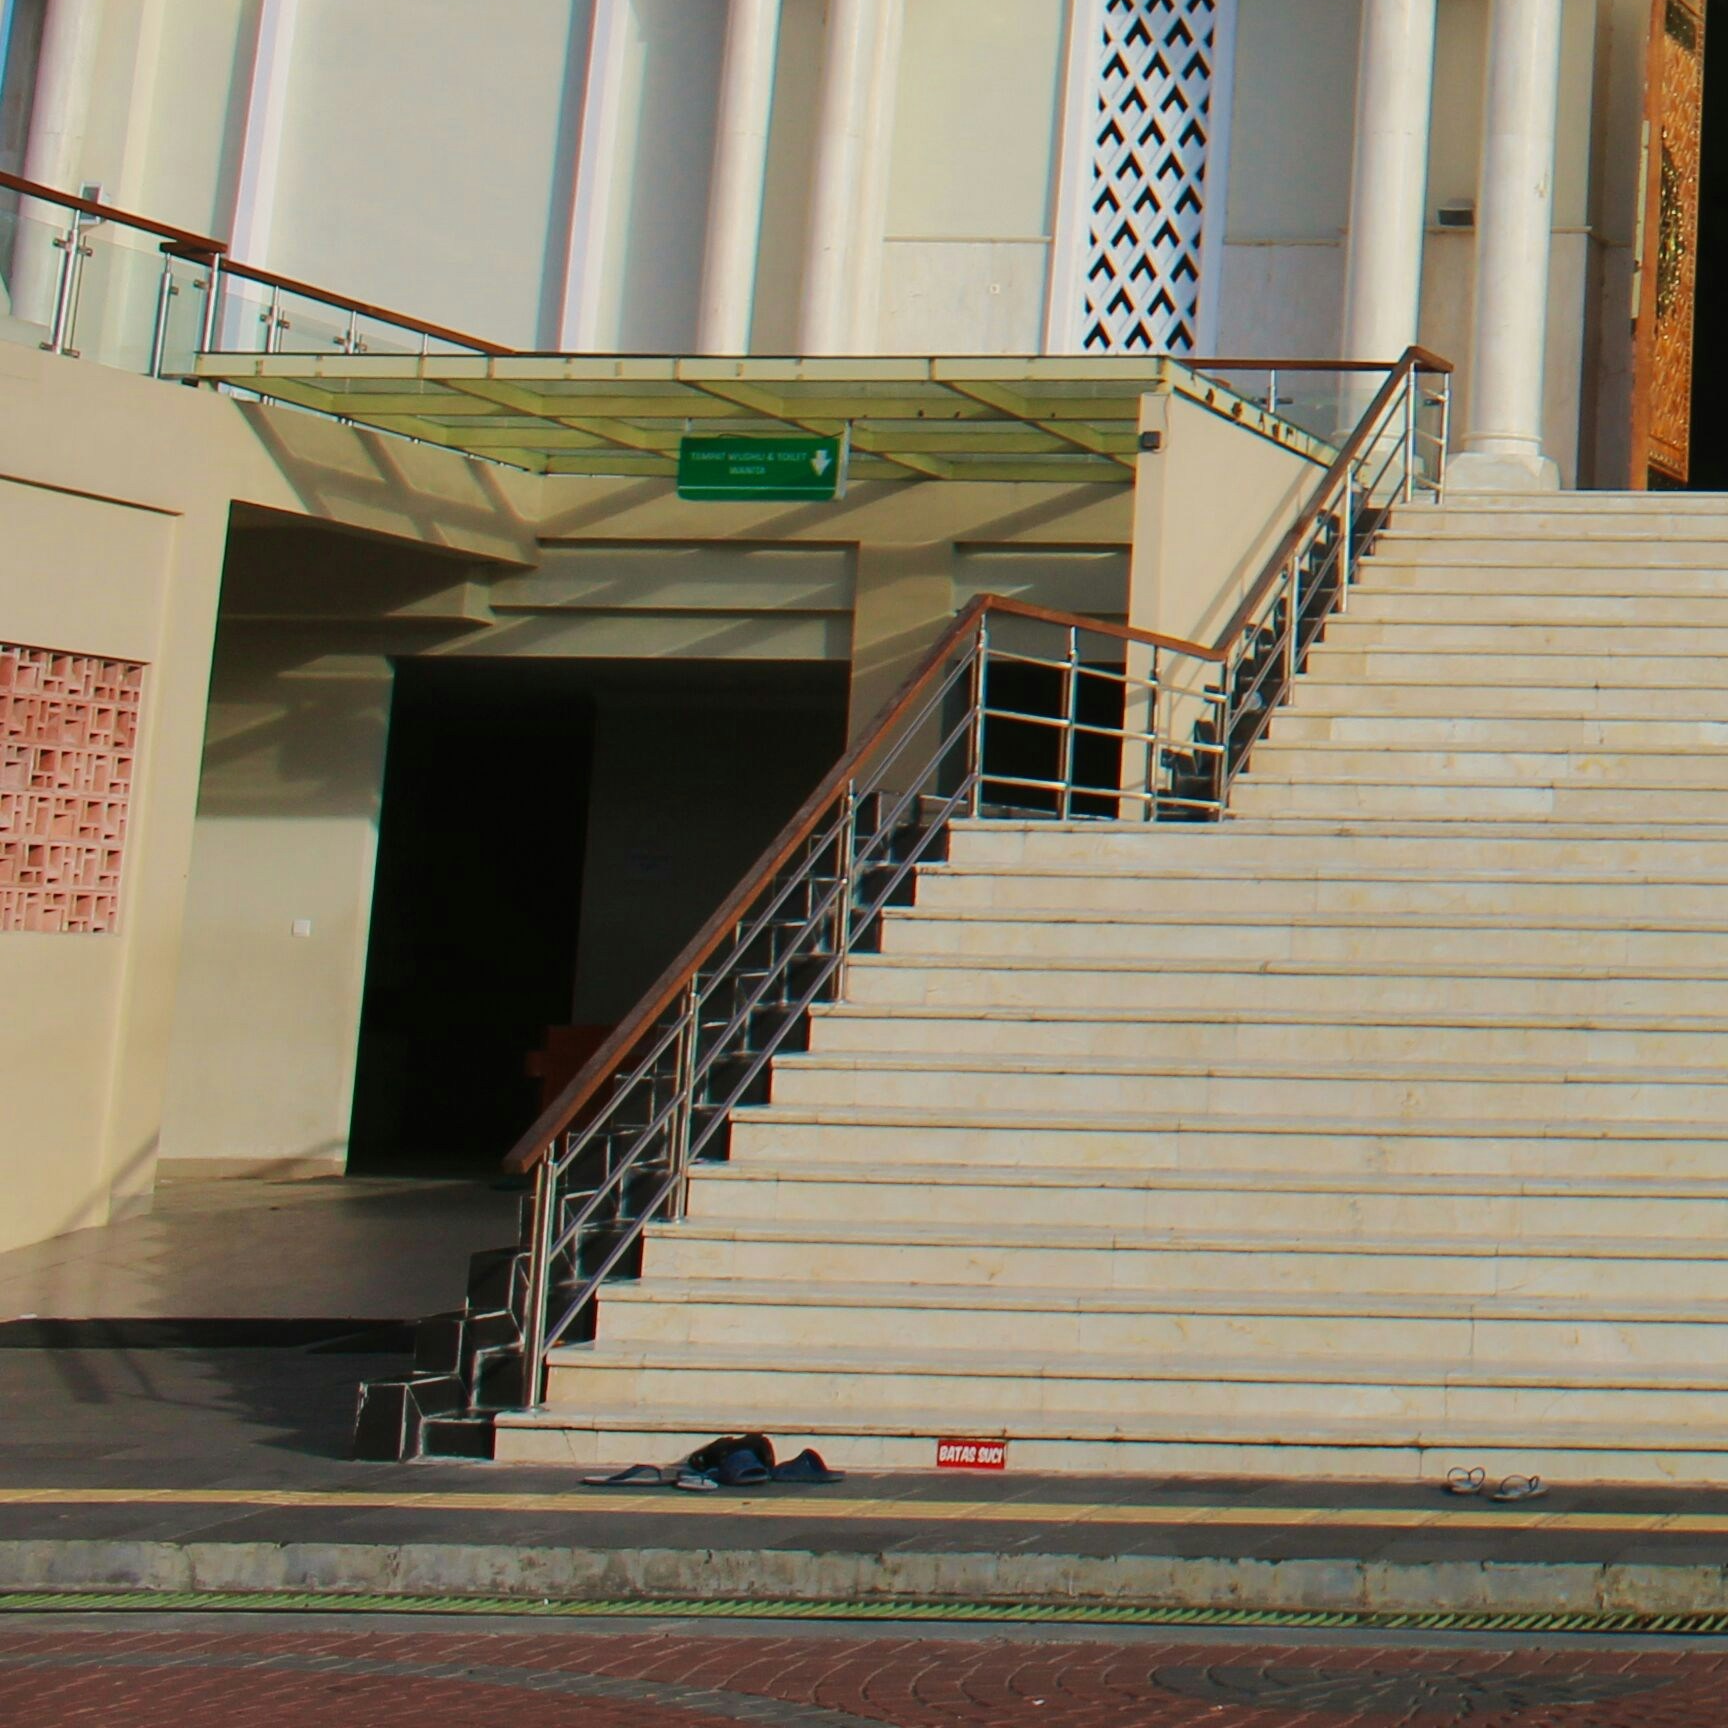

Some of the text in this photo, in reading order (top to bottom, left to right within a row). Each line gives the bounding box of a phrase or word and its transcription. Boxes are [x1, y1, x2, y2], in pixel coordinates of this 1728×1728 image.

[777, 452, 807, 461] TOILET
[939, 1445, 1004, 1464] BATAS SUCI
